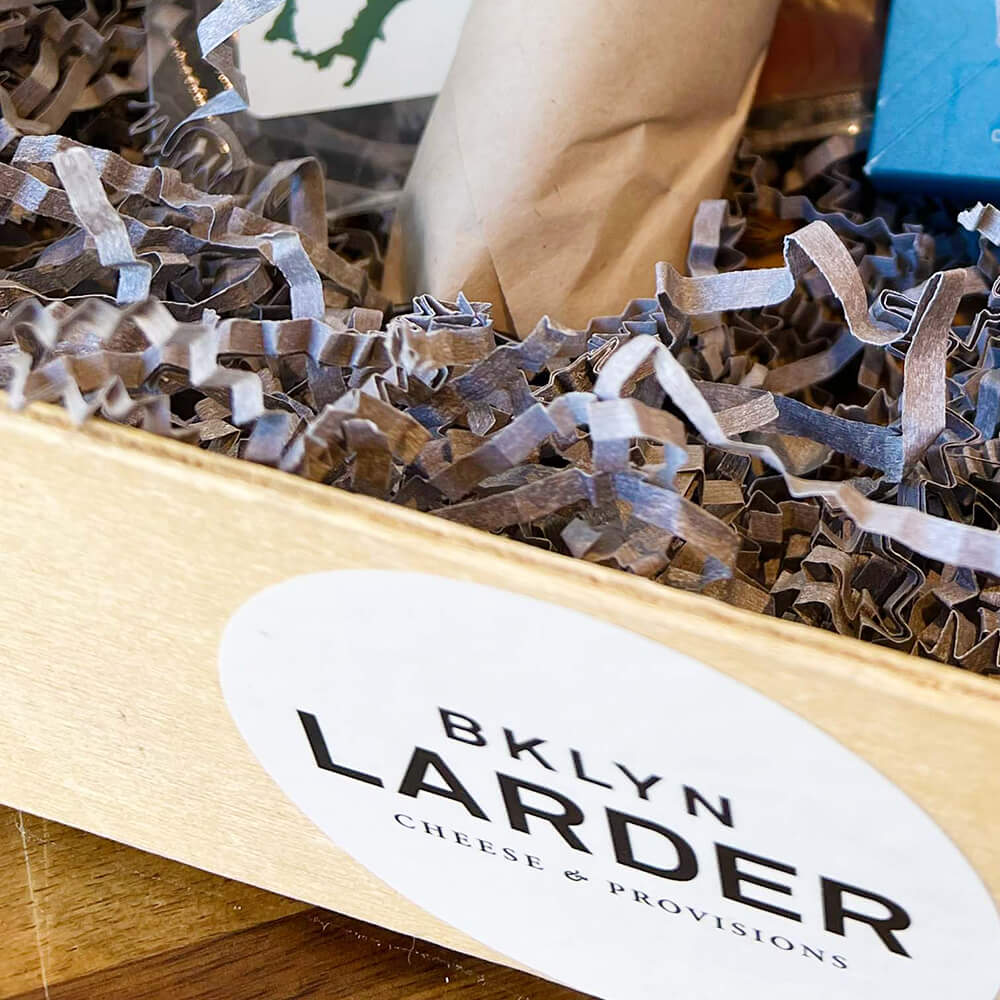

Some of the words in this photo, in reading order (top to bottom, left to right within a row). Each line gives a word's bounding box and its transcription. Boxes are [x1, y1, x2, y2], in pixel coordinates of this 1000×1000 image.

[296, 708, 913, 960] LARDER
[438, 706, 734, 829] BKLYN
[394, 813, 545, 872] CHEESE
[564, 868, 589, 883] &
[607, 880, 850, 970] PROVISIONS
